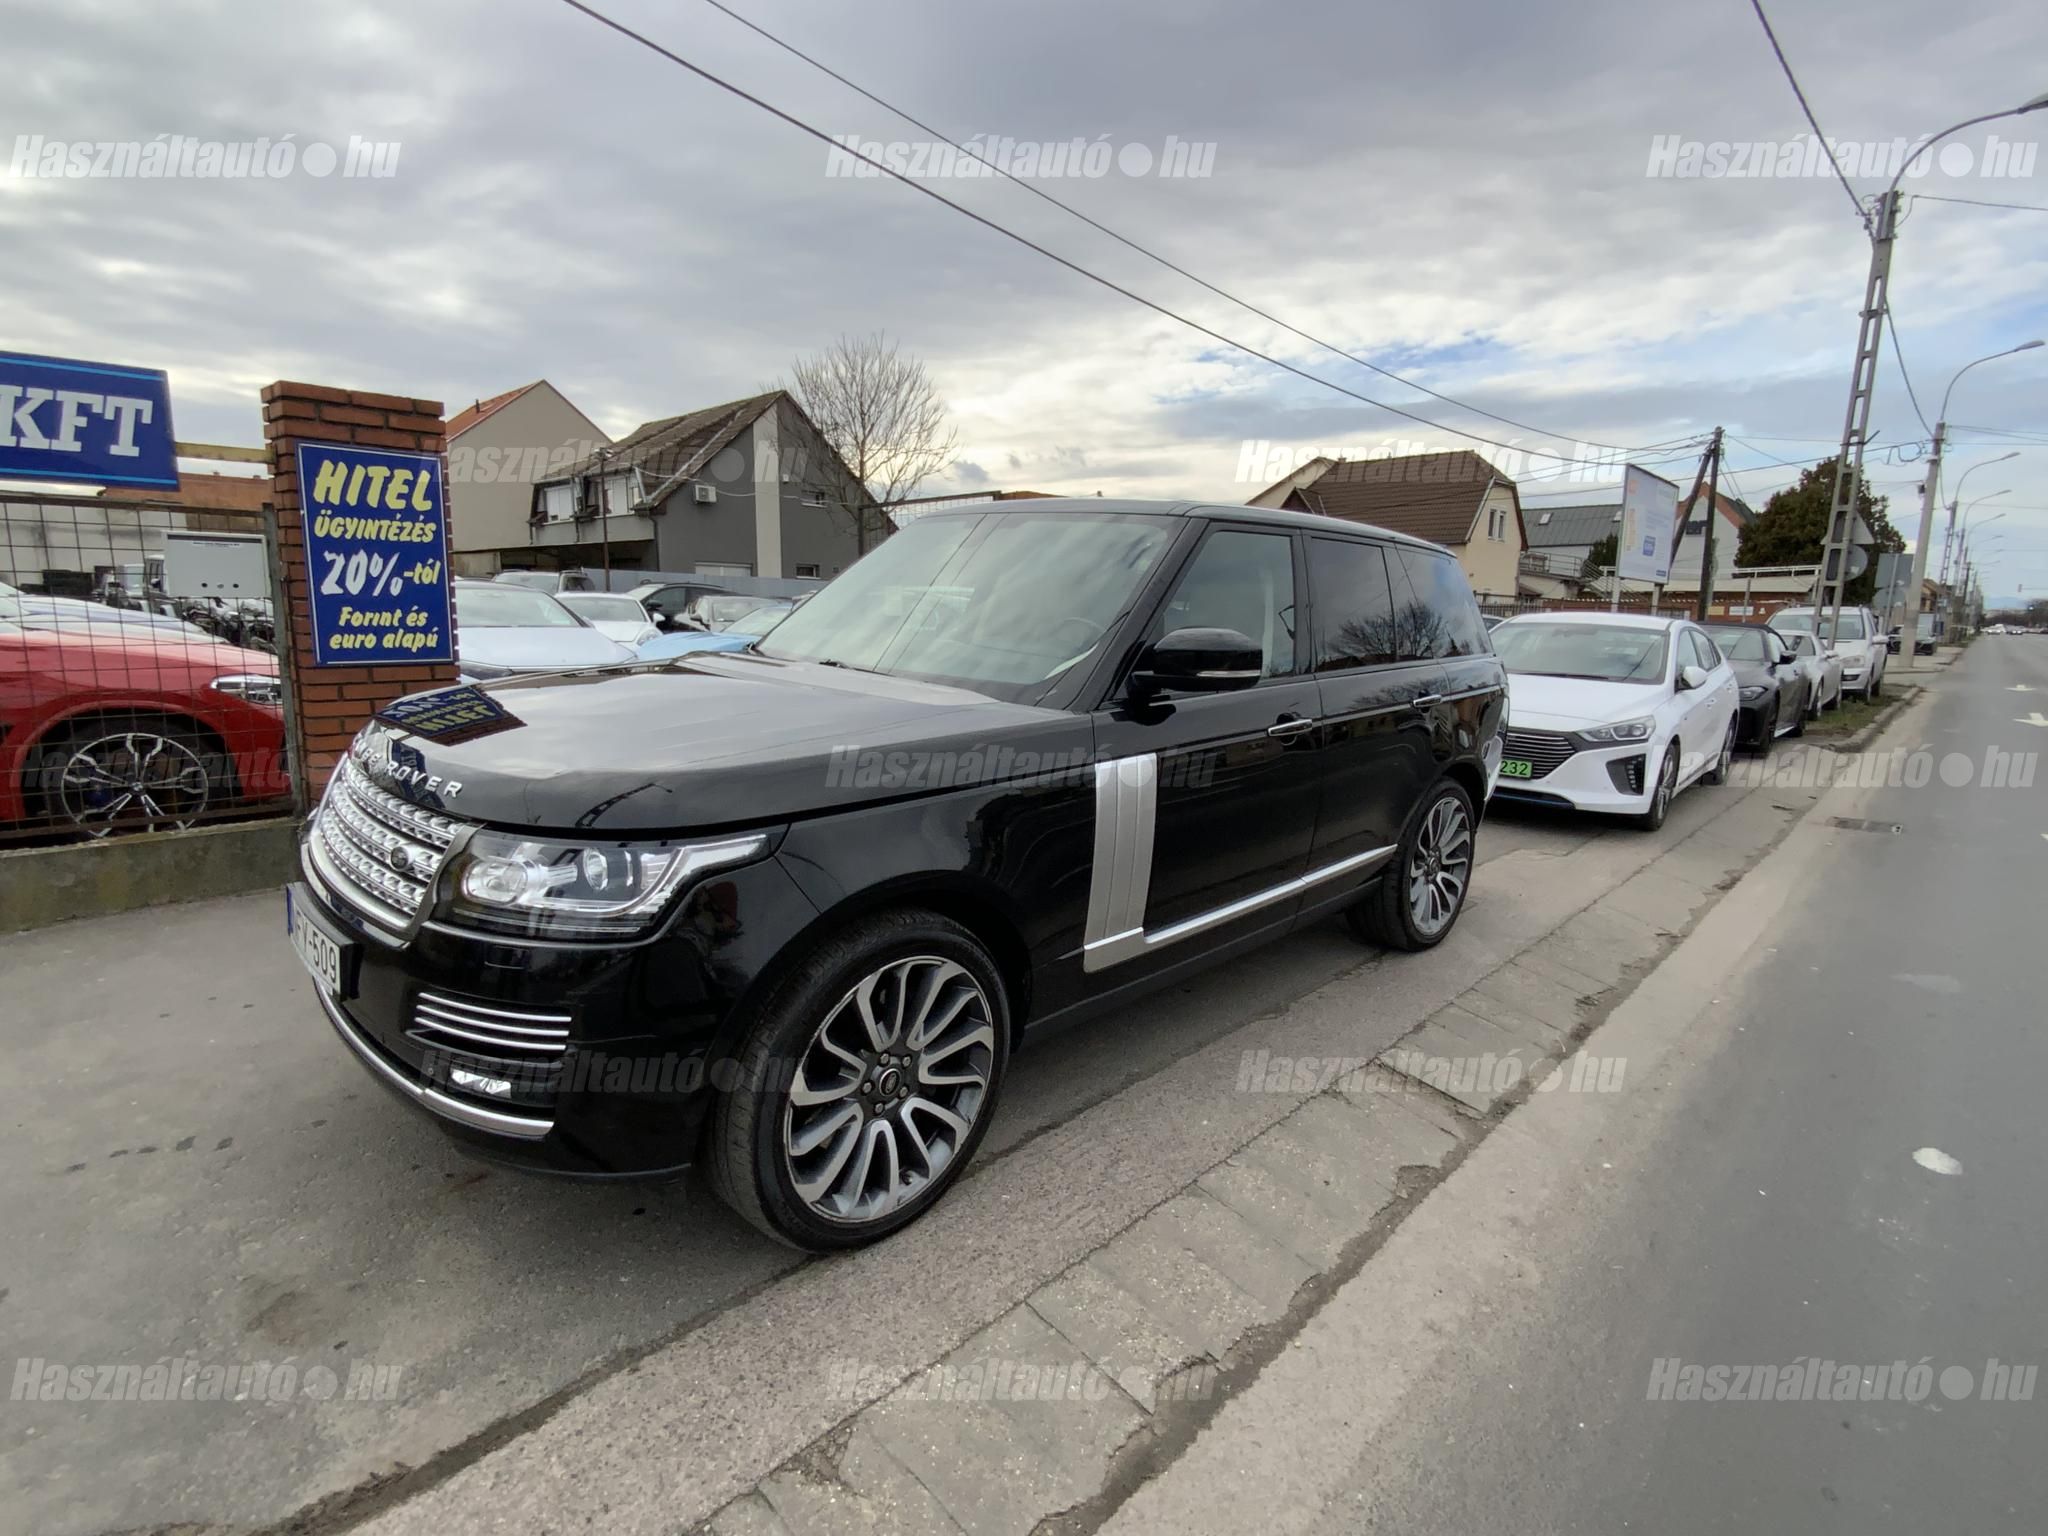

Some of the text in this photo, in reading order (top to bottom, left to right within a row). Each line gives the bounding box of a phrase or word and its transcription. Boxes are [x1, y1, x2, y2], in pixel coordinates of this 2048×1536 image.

[0, 384, 153, 457] KFT
[313, 459, 432, 511] HITEL
[314, 509, 436, 543] ÜGYINTÉZÉS
[339, 605, 429, 628] Forint és
[329, 627, 440, 653] euro alapú
[385, 760, 463, 798] ROVER
[1500, 761, 1529, 776] 232
